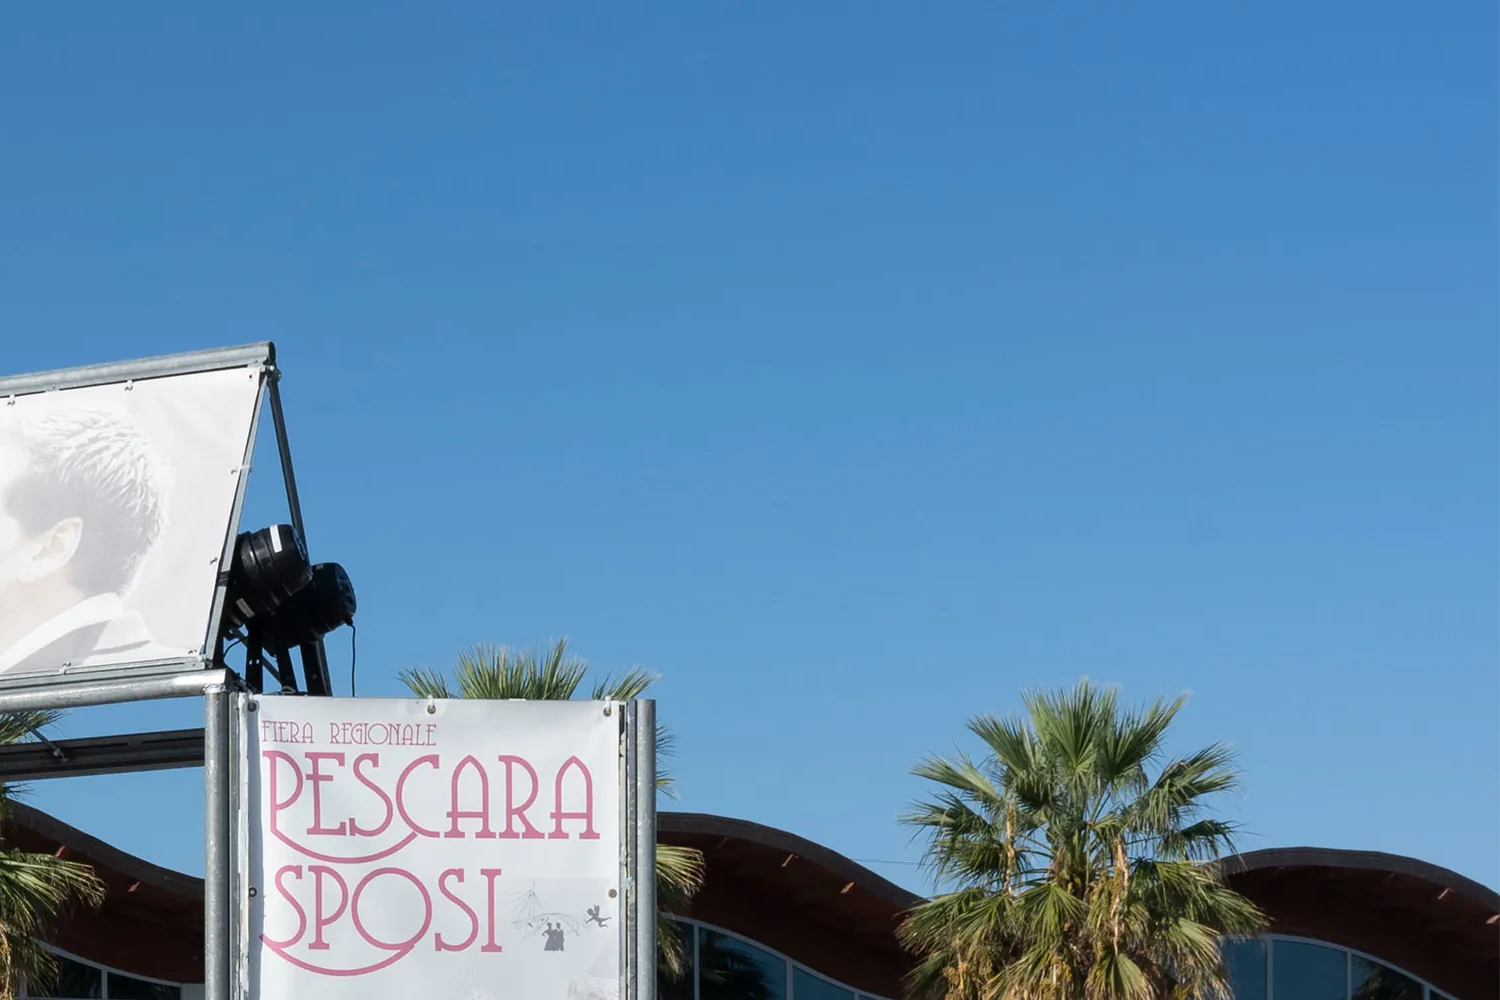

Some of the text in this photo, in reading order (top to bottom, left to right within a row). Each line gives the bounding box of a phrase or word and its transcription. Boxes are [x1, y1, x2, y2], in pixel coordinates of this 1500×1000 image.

[262, 720, 437, 747] FIERA REGIONALE
[262, 749, 601, 864] PESCARA
[260, 864, 503, 977] SPOSI
